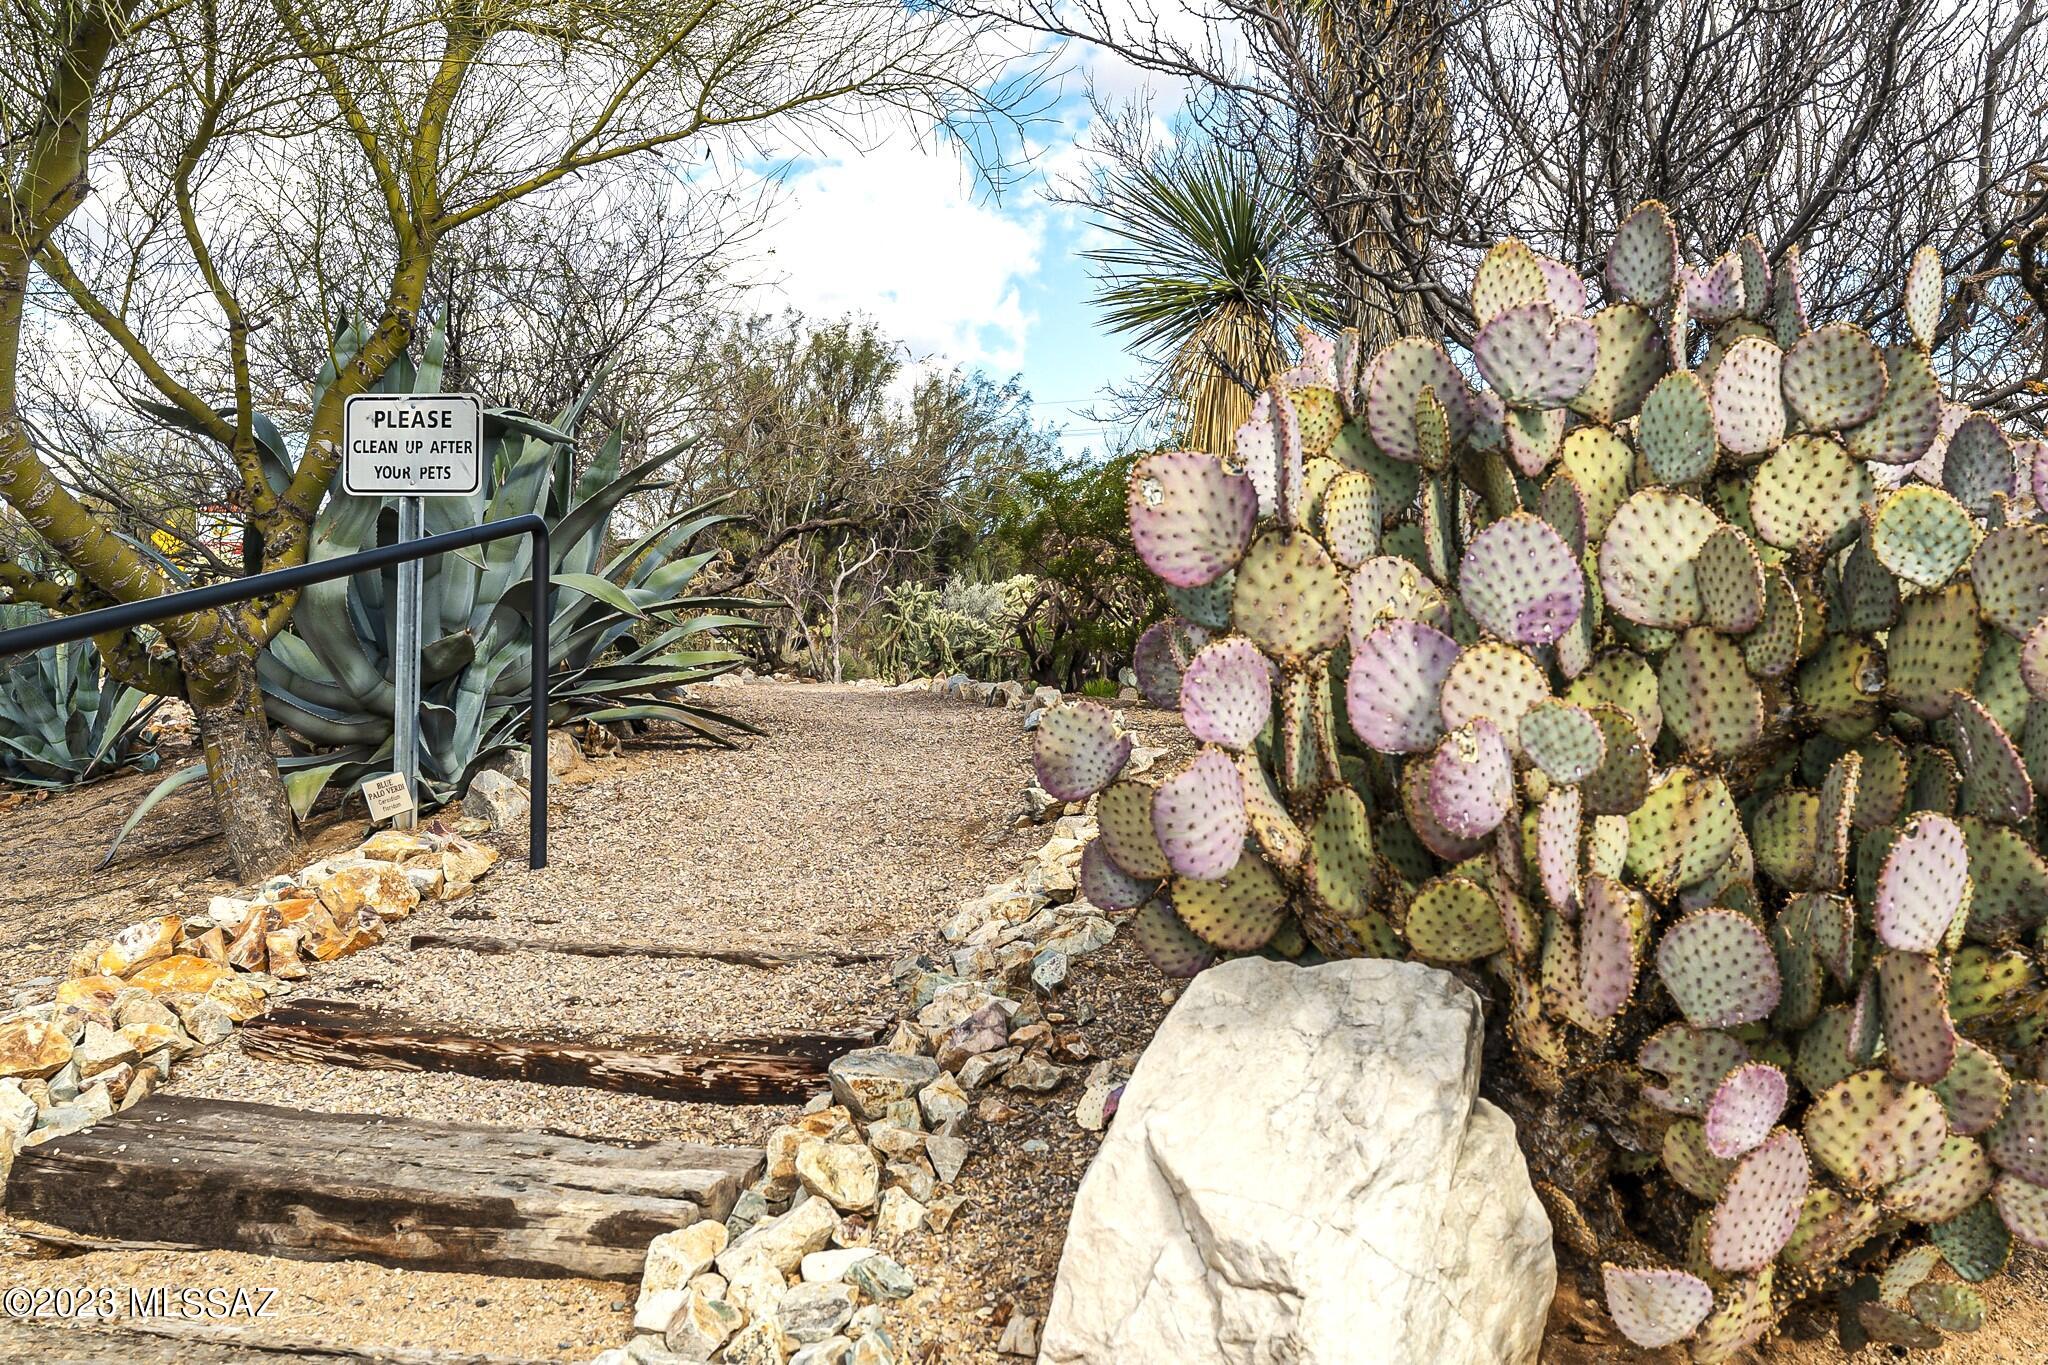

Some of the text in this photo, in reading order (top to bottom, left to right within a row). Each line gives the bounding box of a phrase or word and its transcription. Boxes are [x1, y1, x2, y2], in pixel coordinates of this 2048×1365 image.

[374, 410, 452, 429] PLEASE
[353, 440, 473, 454] CLEAN UP AFTER
[374, 465, 451, 480] YOUR PETS
[376, 778, 394, 790] BLUE
[368, 789, 386, 801] PALO
